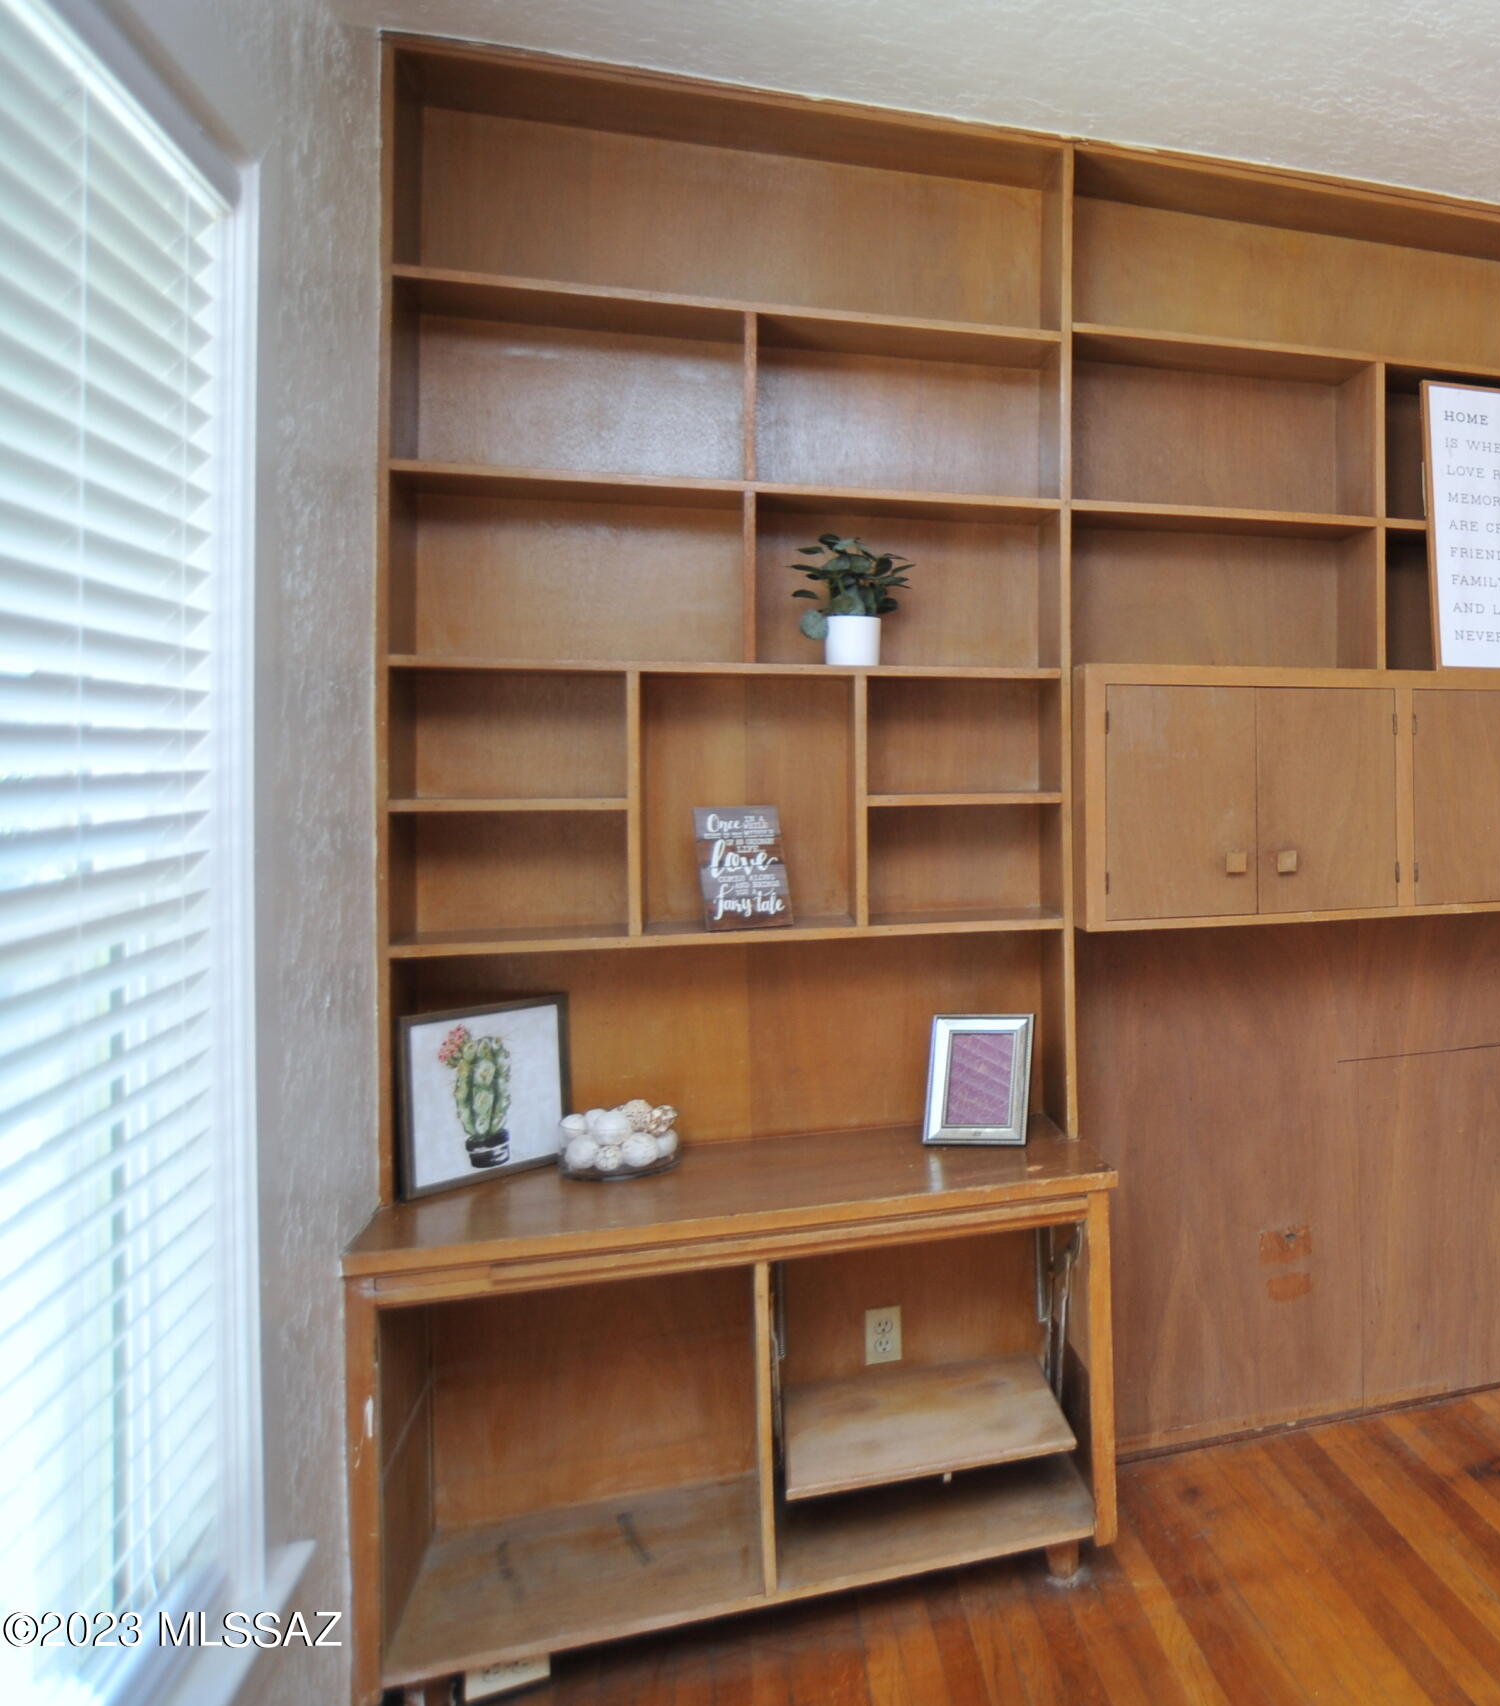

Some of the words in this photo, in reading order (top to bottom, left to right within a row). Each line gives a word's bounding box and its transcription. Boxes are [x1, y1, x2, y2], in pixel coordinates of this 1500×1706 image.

[1444, 410, 1489, 426] HOME
[1445, 438, 1459, 450] IS
[1446, 464, 1485, 480] LOVE
[1449, 520, 1479, 533] ARE
[1452, 602, 1485, 615] AND
[707, 814, 743, 833] Once
